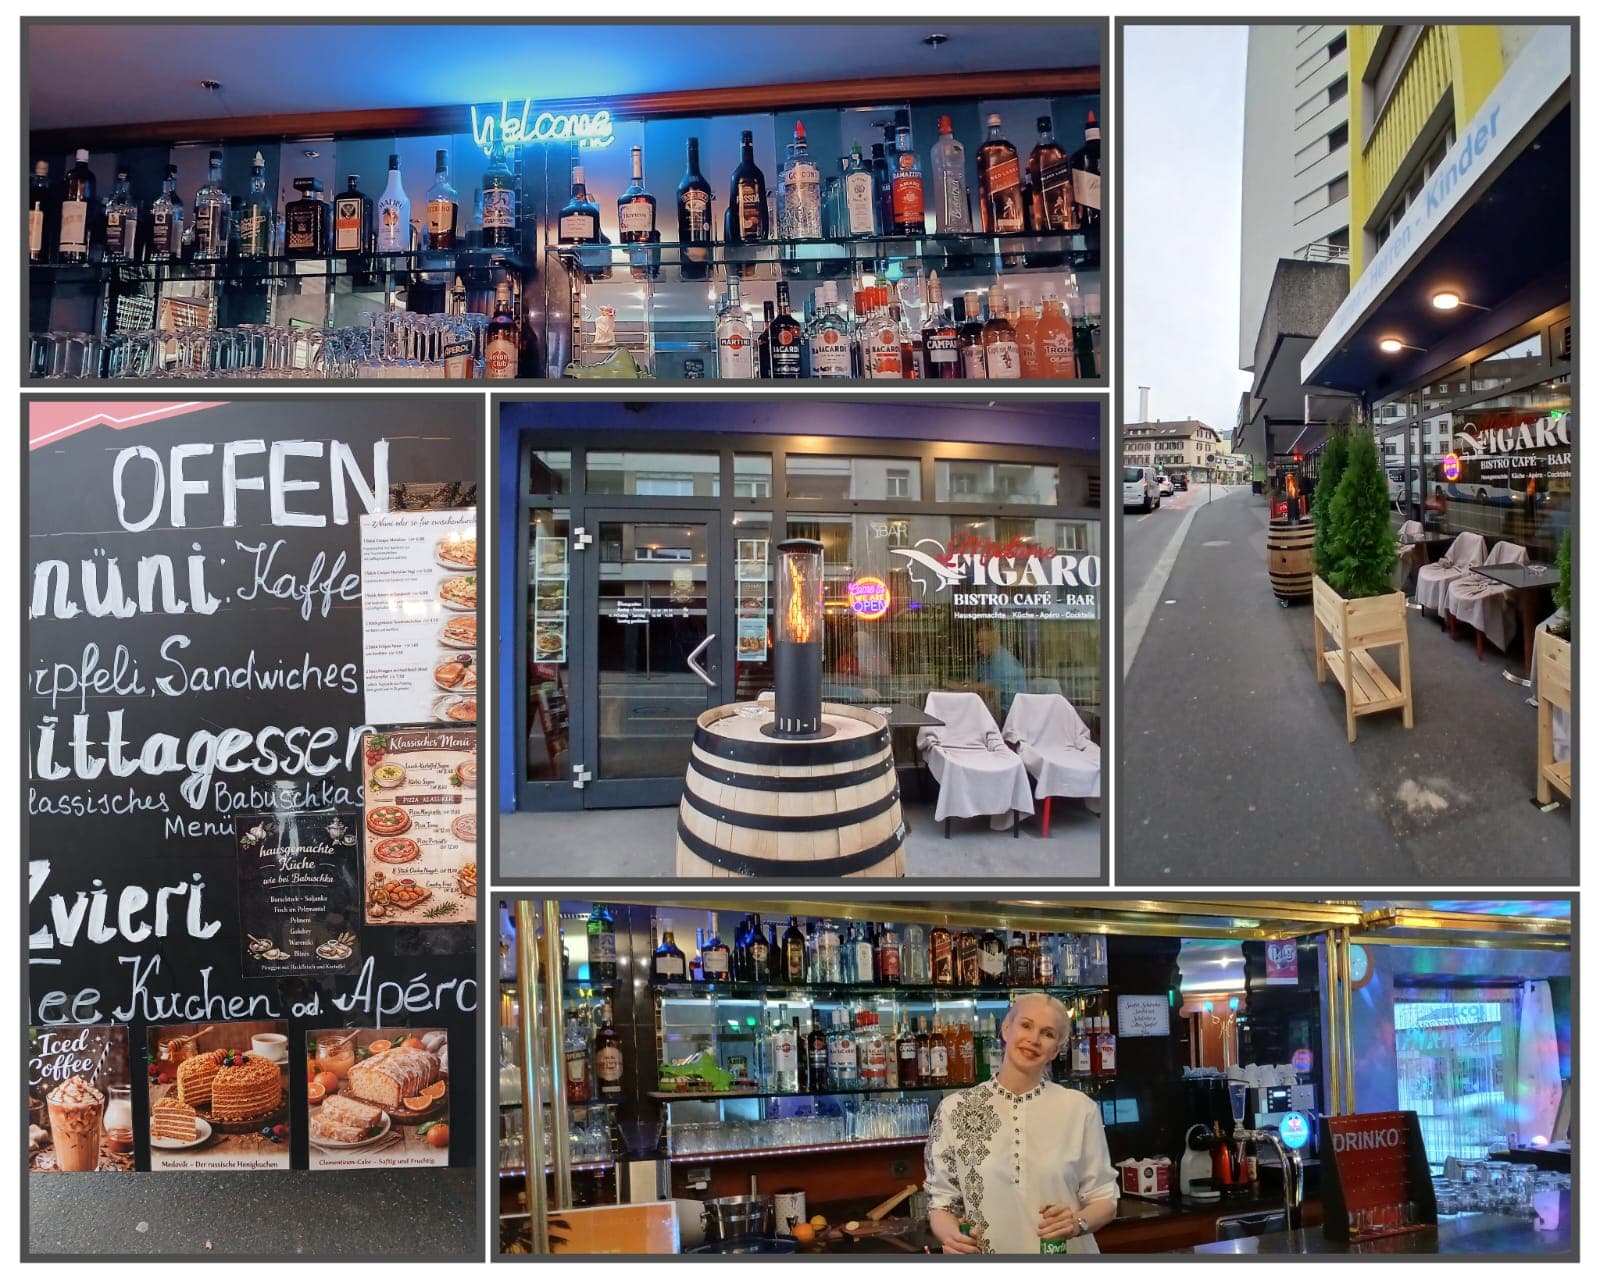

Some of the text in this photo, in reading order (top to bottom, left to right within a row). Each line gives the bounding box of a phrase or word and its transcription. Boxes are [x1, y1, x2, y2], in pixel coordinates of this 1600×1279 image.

[470, 98, 615, 151] Welcome
[1426, 104, 1500, 216] Kinder
[927, 340, 957, 349] CAMPA
[1481, 458, 1510, 470] BISTRO
[112, 438, 390, 532] OFFEN
[880, 525, 907, 537] BAR
[854, 600, 886, 612] OPEN
[954, 594, 1008, 606] BISTRO
[1014, 591, 1051, 606] CAFÉ
[1067, 594, 1095, 606] BAR
[156, 635, 358, 697] Sandwiches
[389, 735, 470, 750] Klassisches Menü
[165, 815, 235, 840] Menü
[260, 843, 335, 857] hausgemachte
[279, 857, 316, 871] Küche
[278, 875, 290, 883] bei
[292, 993, 323, 1018] od.
[38, 1029, 88, 1057] Iced
[29, 1056, 94, 1085] Coffee
[1332, 1128, 1399, 1152] DRINKO
[195, 1160, 206, 1168] Der
